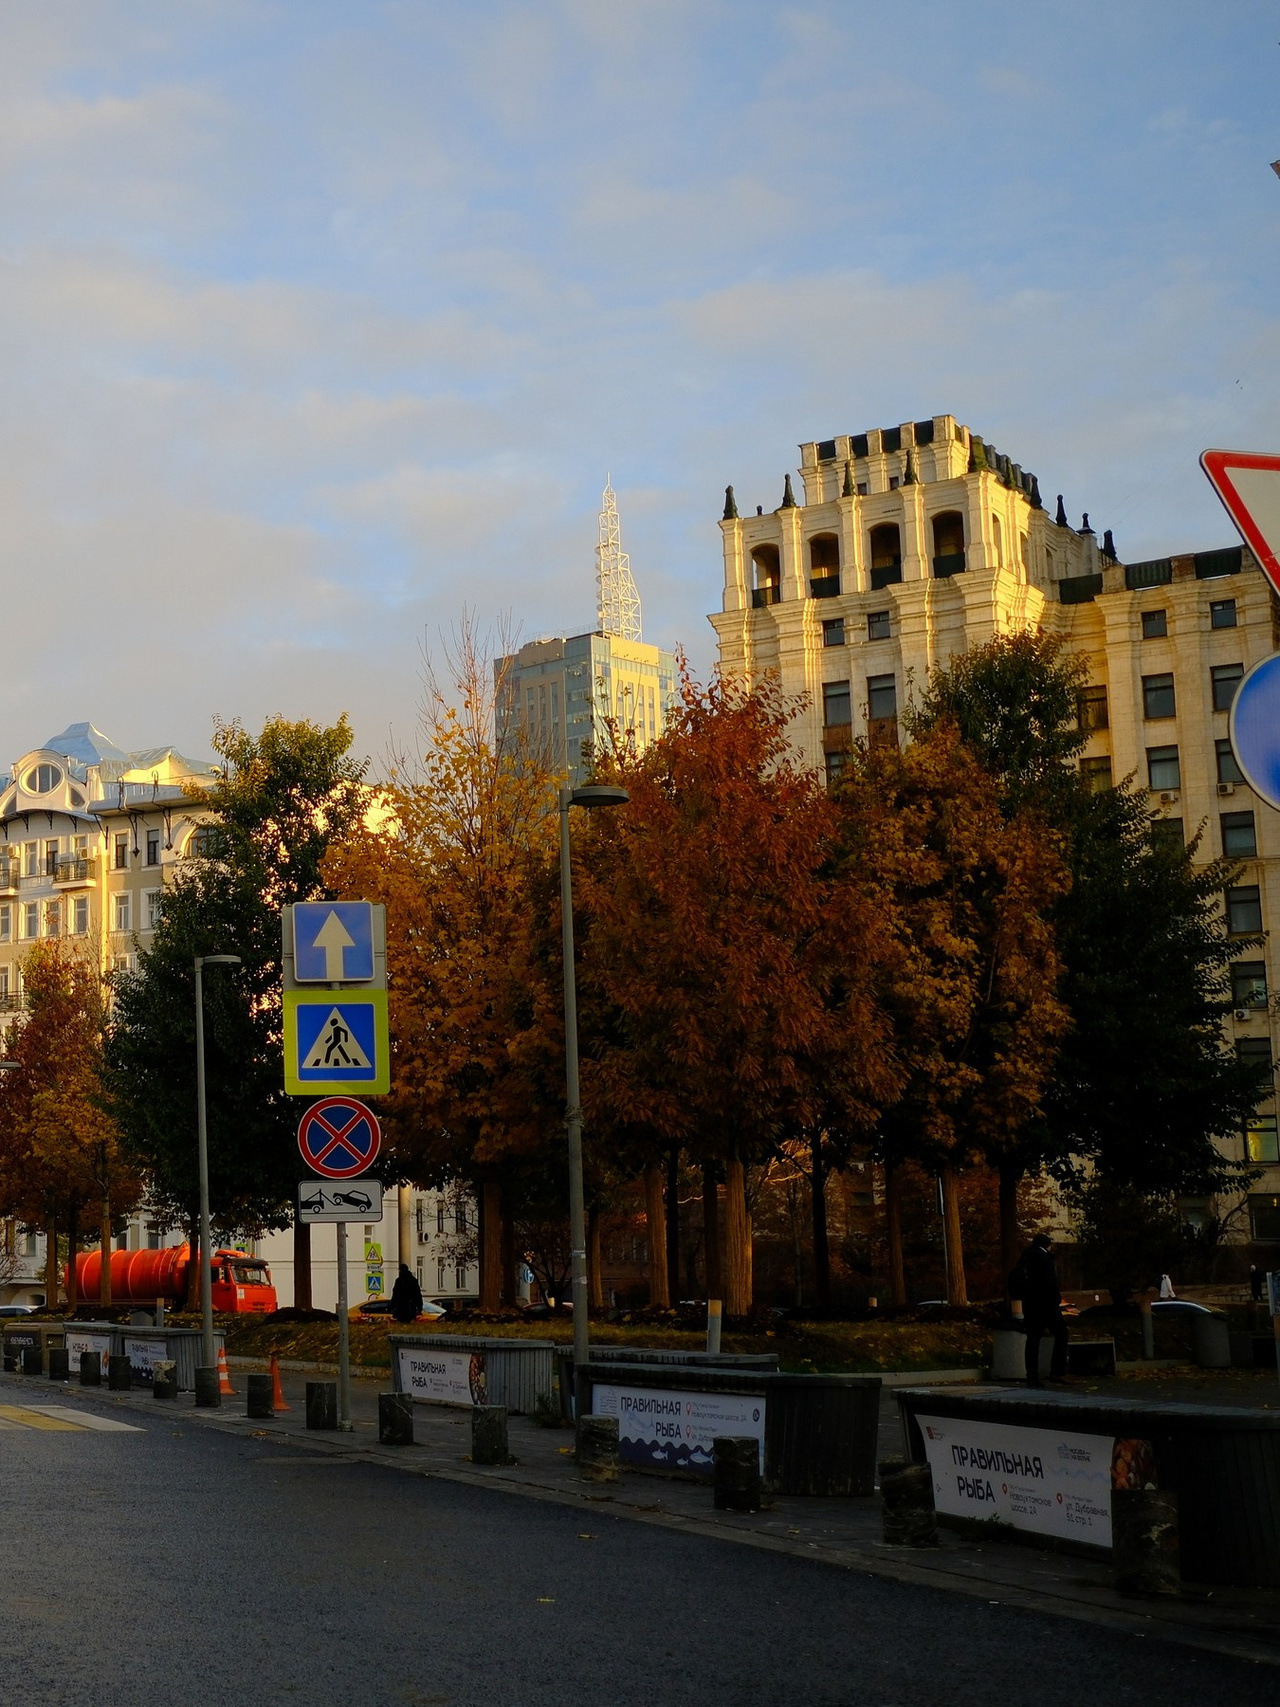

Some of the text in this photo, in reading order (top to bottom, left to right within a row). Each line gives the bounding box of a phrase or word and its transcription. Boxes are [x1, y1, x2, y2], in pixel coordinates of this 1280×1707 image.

[411, 1361, 446, 1375] ПРАВИЛЬНАЯ
[412, 1376, 428, 1388] РЫБА
[620, 1396, 682, 1416] ПРАВИЛЬНАЯ
[655, 1422, 683, 1439] РЫБА
[951, 1444, 1044, 1479] ПРАВИЛЬНАЯ
[957, 1476, 996, 1503] РЫБА
